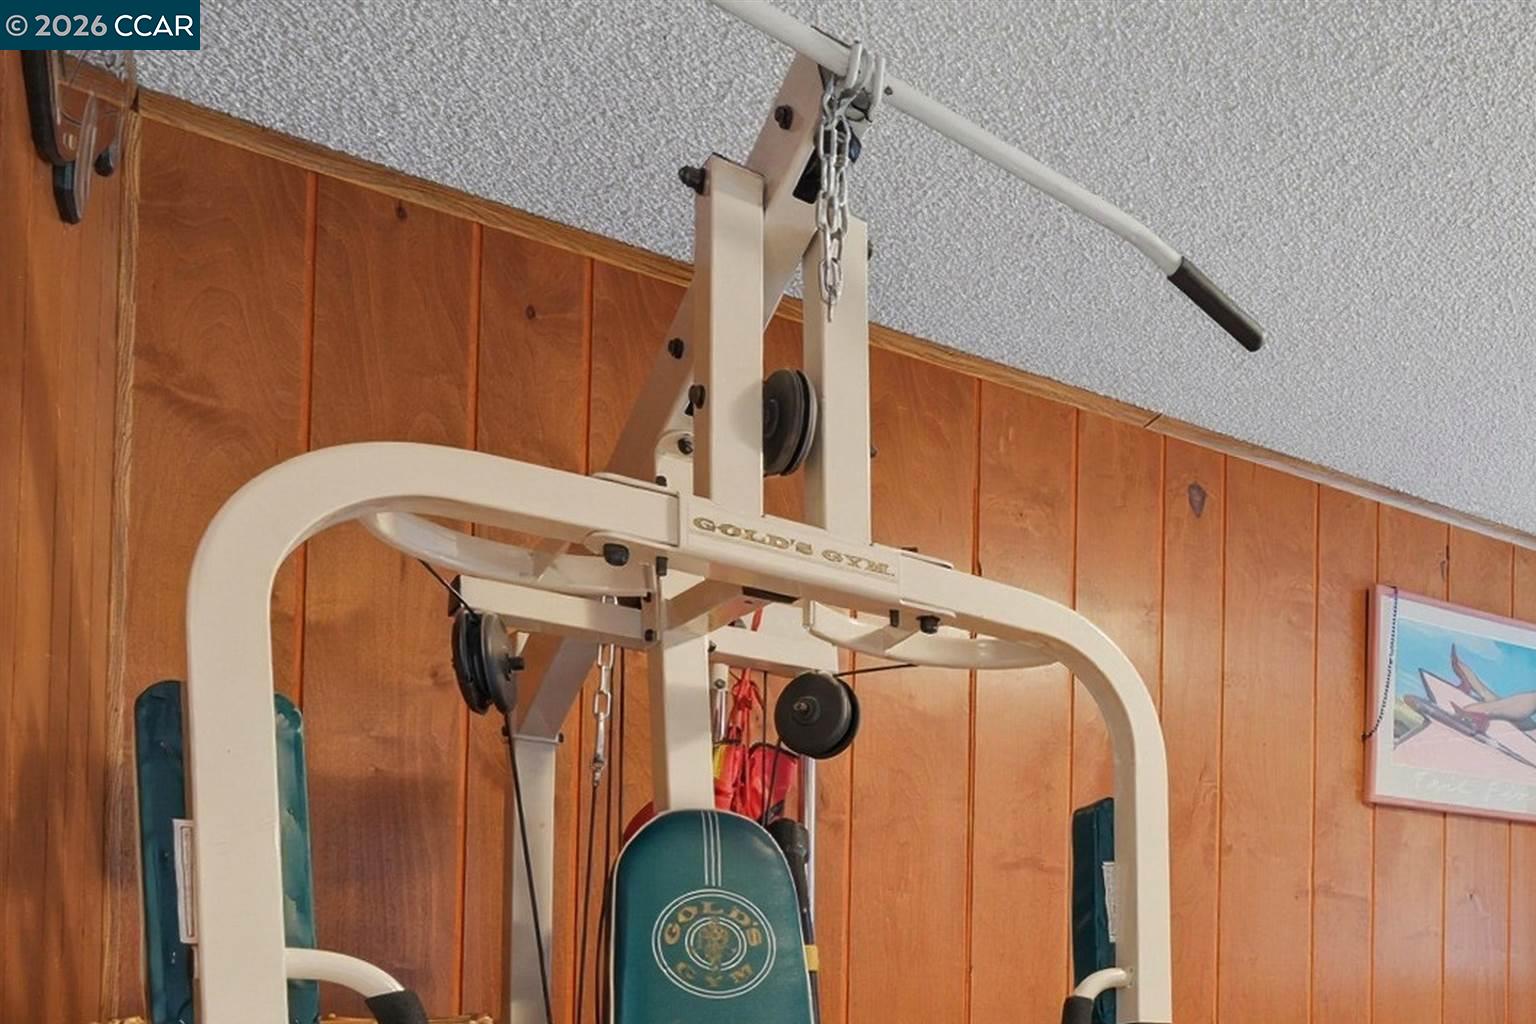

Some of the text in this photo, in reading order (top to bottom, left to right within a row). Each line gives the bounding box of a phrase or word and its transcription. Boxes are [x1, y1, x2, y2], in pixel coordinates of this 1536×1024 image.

[693, 517, 813, 555] GOLD'S
[664, 901, 762, 946] GOLD'S
[675, 961, 752, 987] GYM
